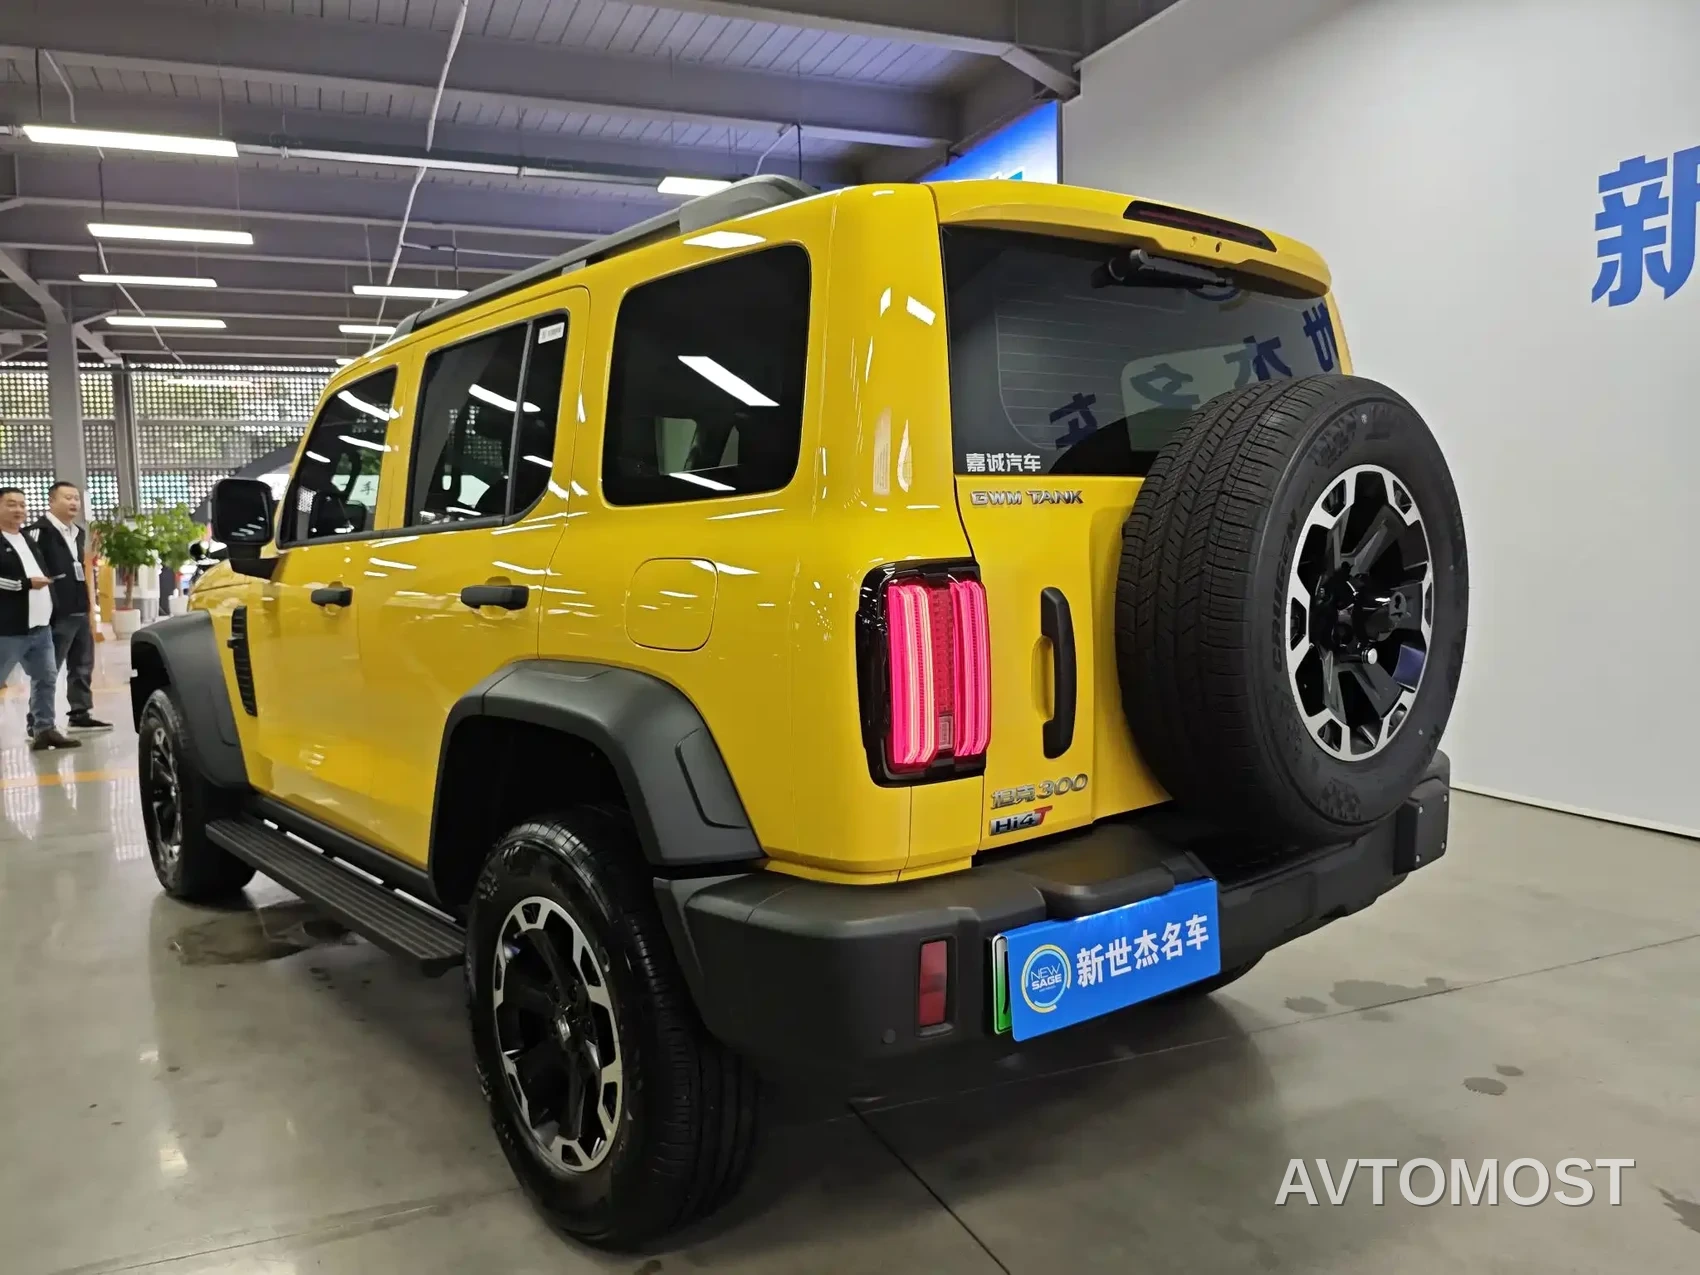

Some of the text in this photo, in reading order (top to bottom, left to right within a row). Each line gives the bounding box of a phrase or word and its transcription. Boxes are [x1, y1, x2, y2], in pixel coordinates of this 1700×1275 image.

[966, 453, 1041, 472] 嘉诚汽车
[971, 490, 1084, 505] GWM TANK
[1076, 914, 1209, 987] 新世杰名车
[1030, 962, 1060, 981] NEW
[1031, 973, 1062, 990] SAGE
